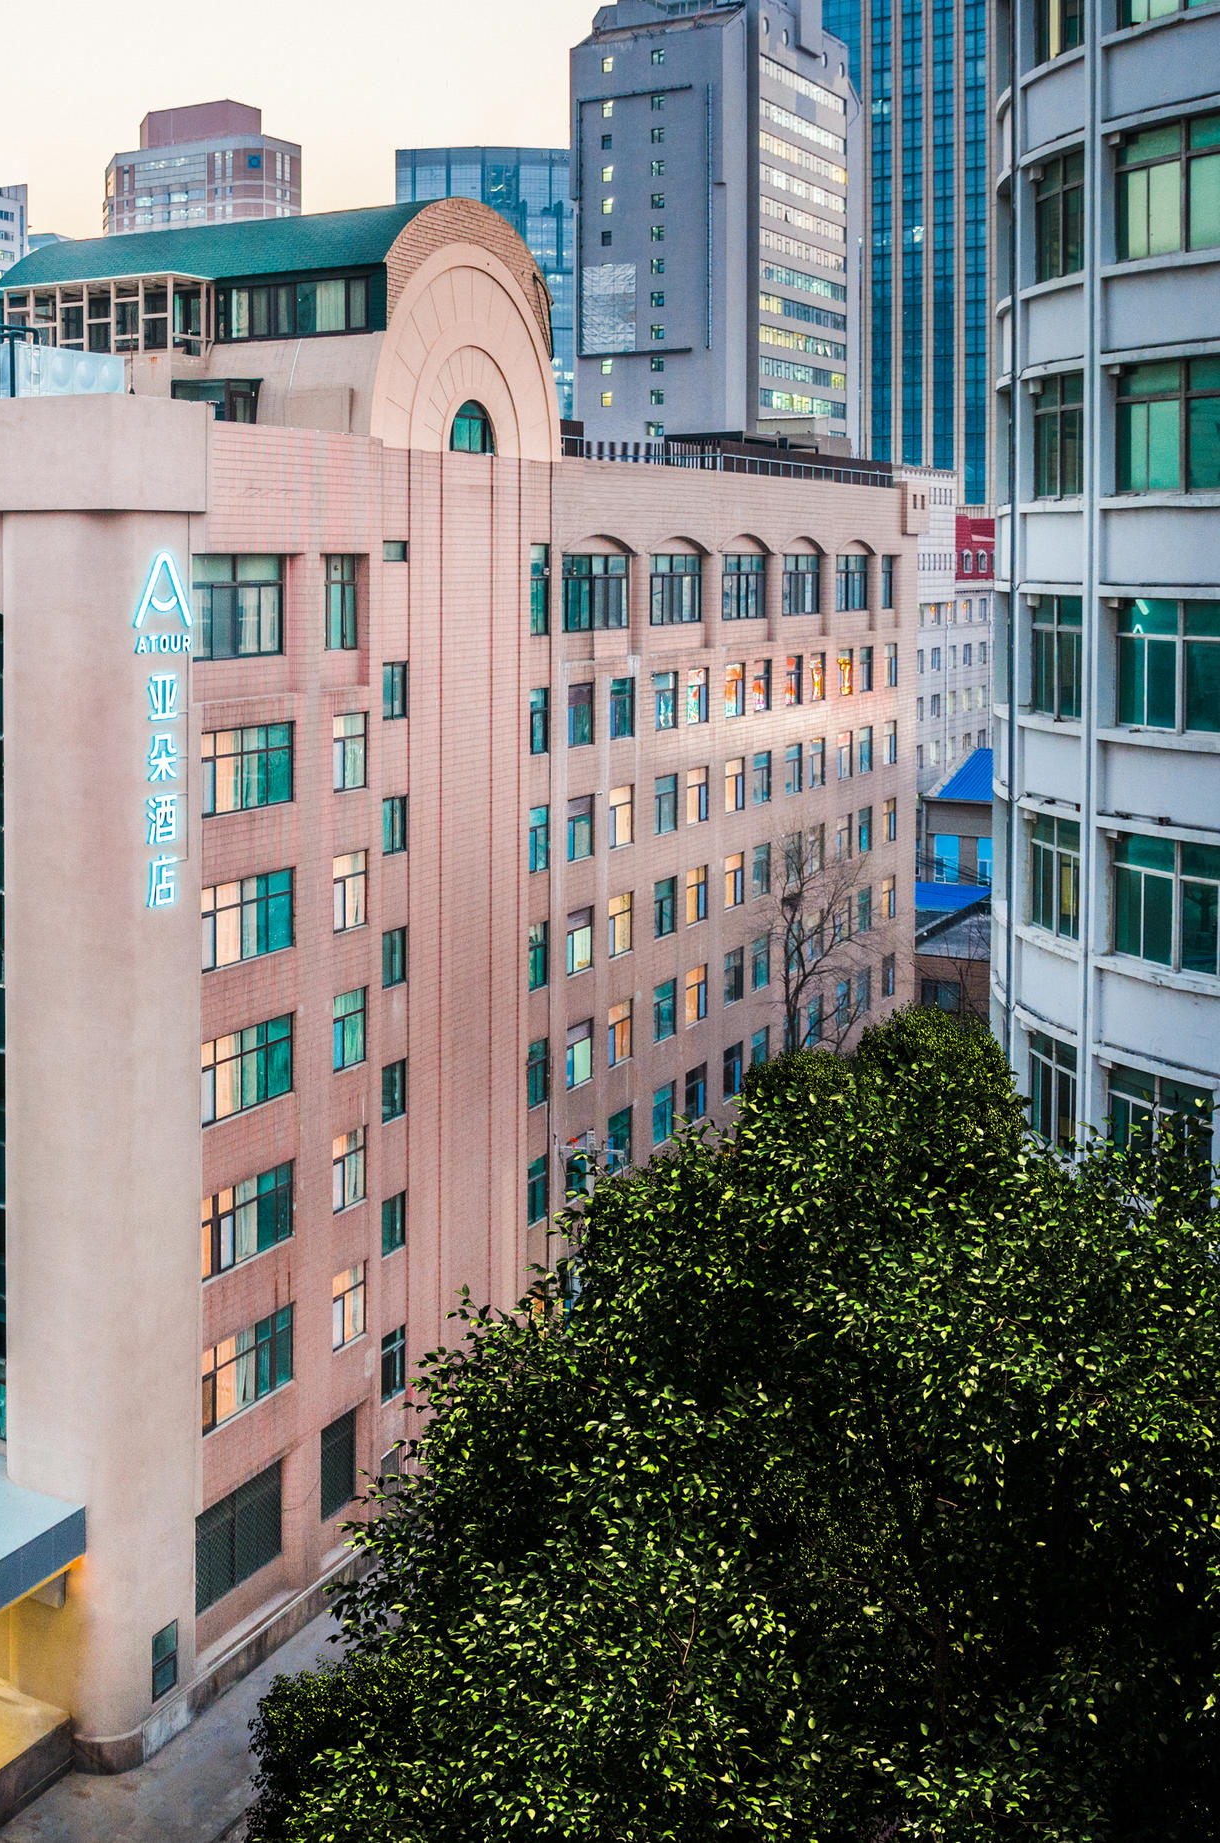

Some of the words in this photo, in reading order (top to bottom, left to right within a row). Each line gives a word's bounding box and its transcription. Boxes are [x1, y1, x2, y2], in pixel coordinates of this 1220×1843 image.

[135, 634, 192, 655] ATOUR
[148, 674, 178, 908] 亚朵酒店
